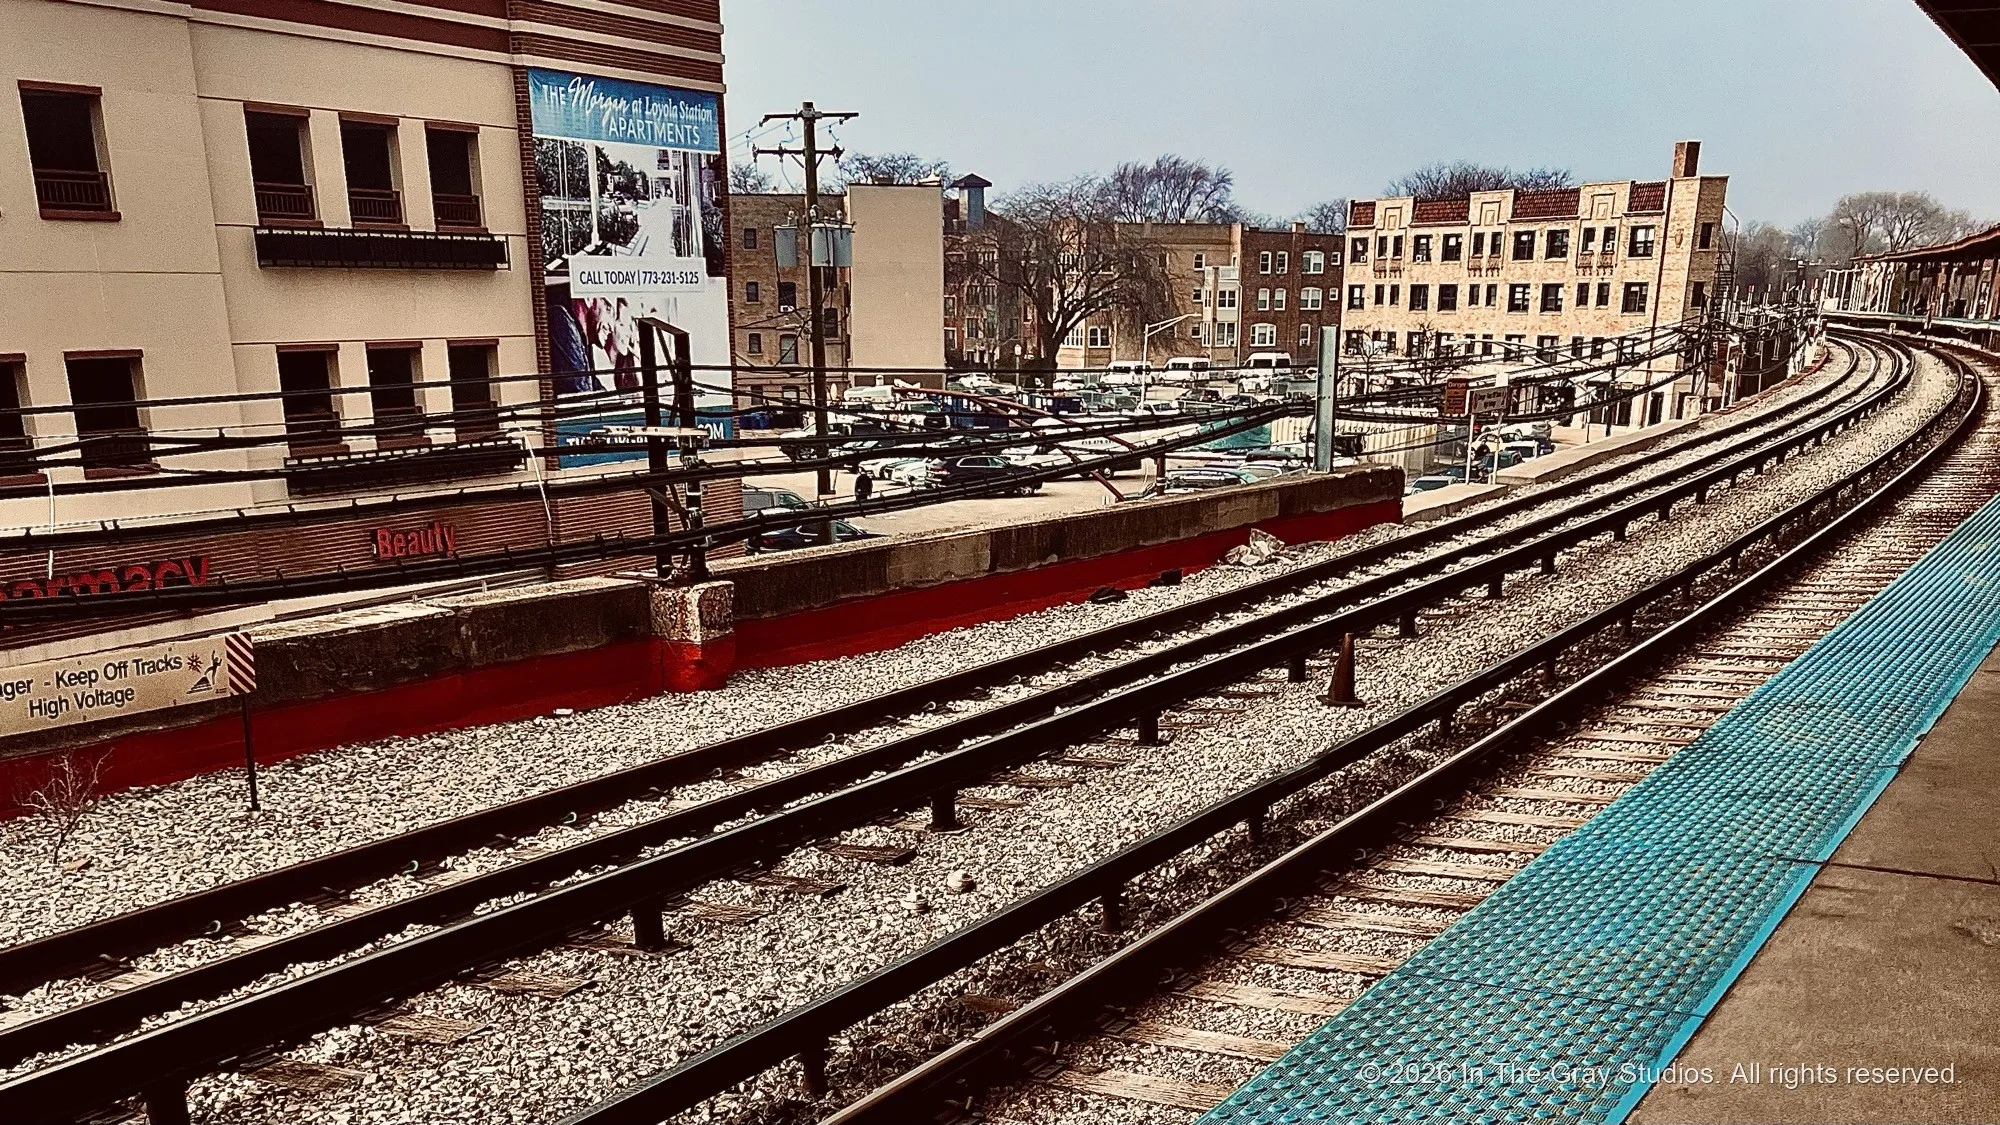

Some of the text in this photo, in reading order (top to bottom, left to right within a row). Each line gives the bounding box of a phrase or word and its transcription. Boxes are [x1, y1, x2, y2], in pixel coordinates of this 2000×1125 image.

[543, 77, 712, 127] THE Morgan at Loyola Station
[608, 117, 700, 145] APARTMENTS
[579, 270, 603, 285] CALL
[605, 271, 636, 285] TODAY
[642, 271, 699, 285] 773-231-5125
[377, 521, 456, 559] Beauty
[0, 679, 34, 701] ger
[55, 669, 99, 690] Keep
[103, 662, 129, 681] Off
[132, 654, 183, 677] Tracks
[29, 687, 135, 719] High Voltage
